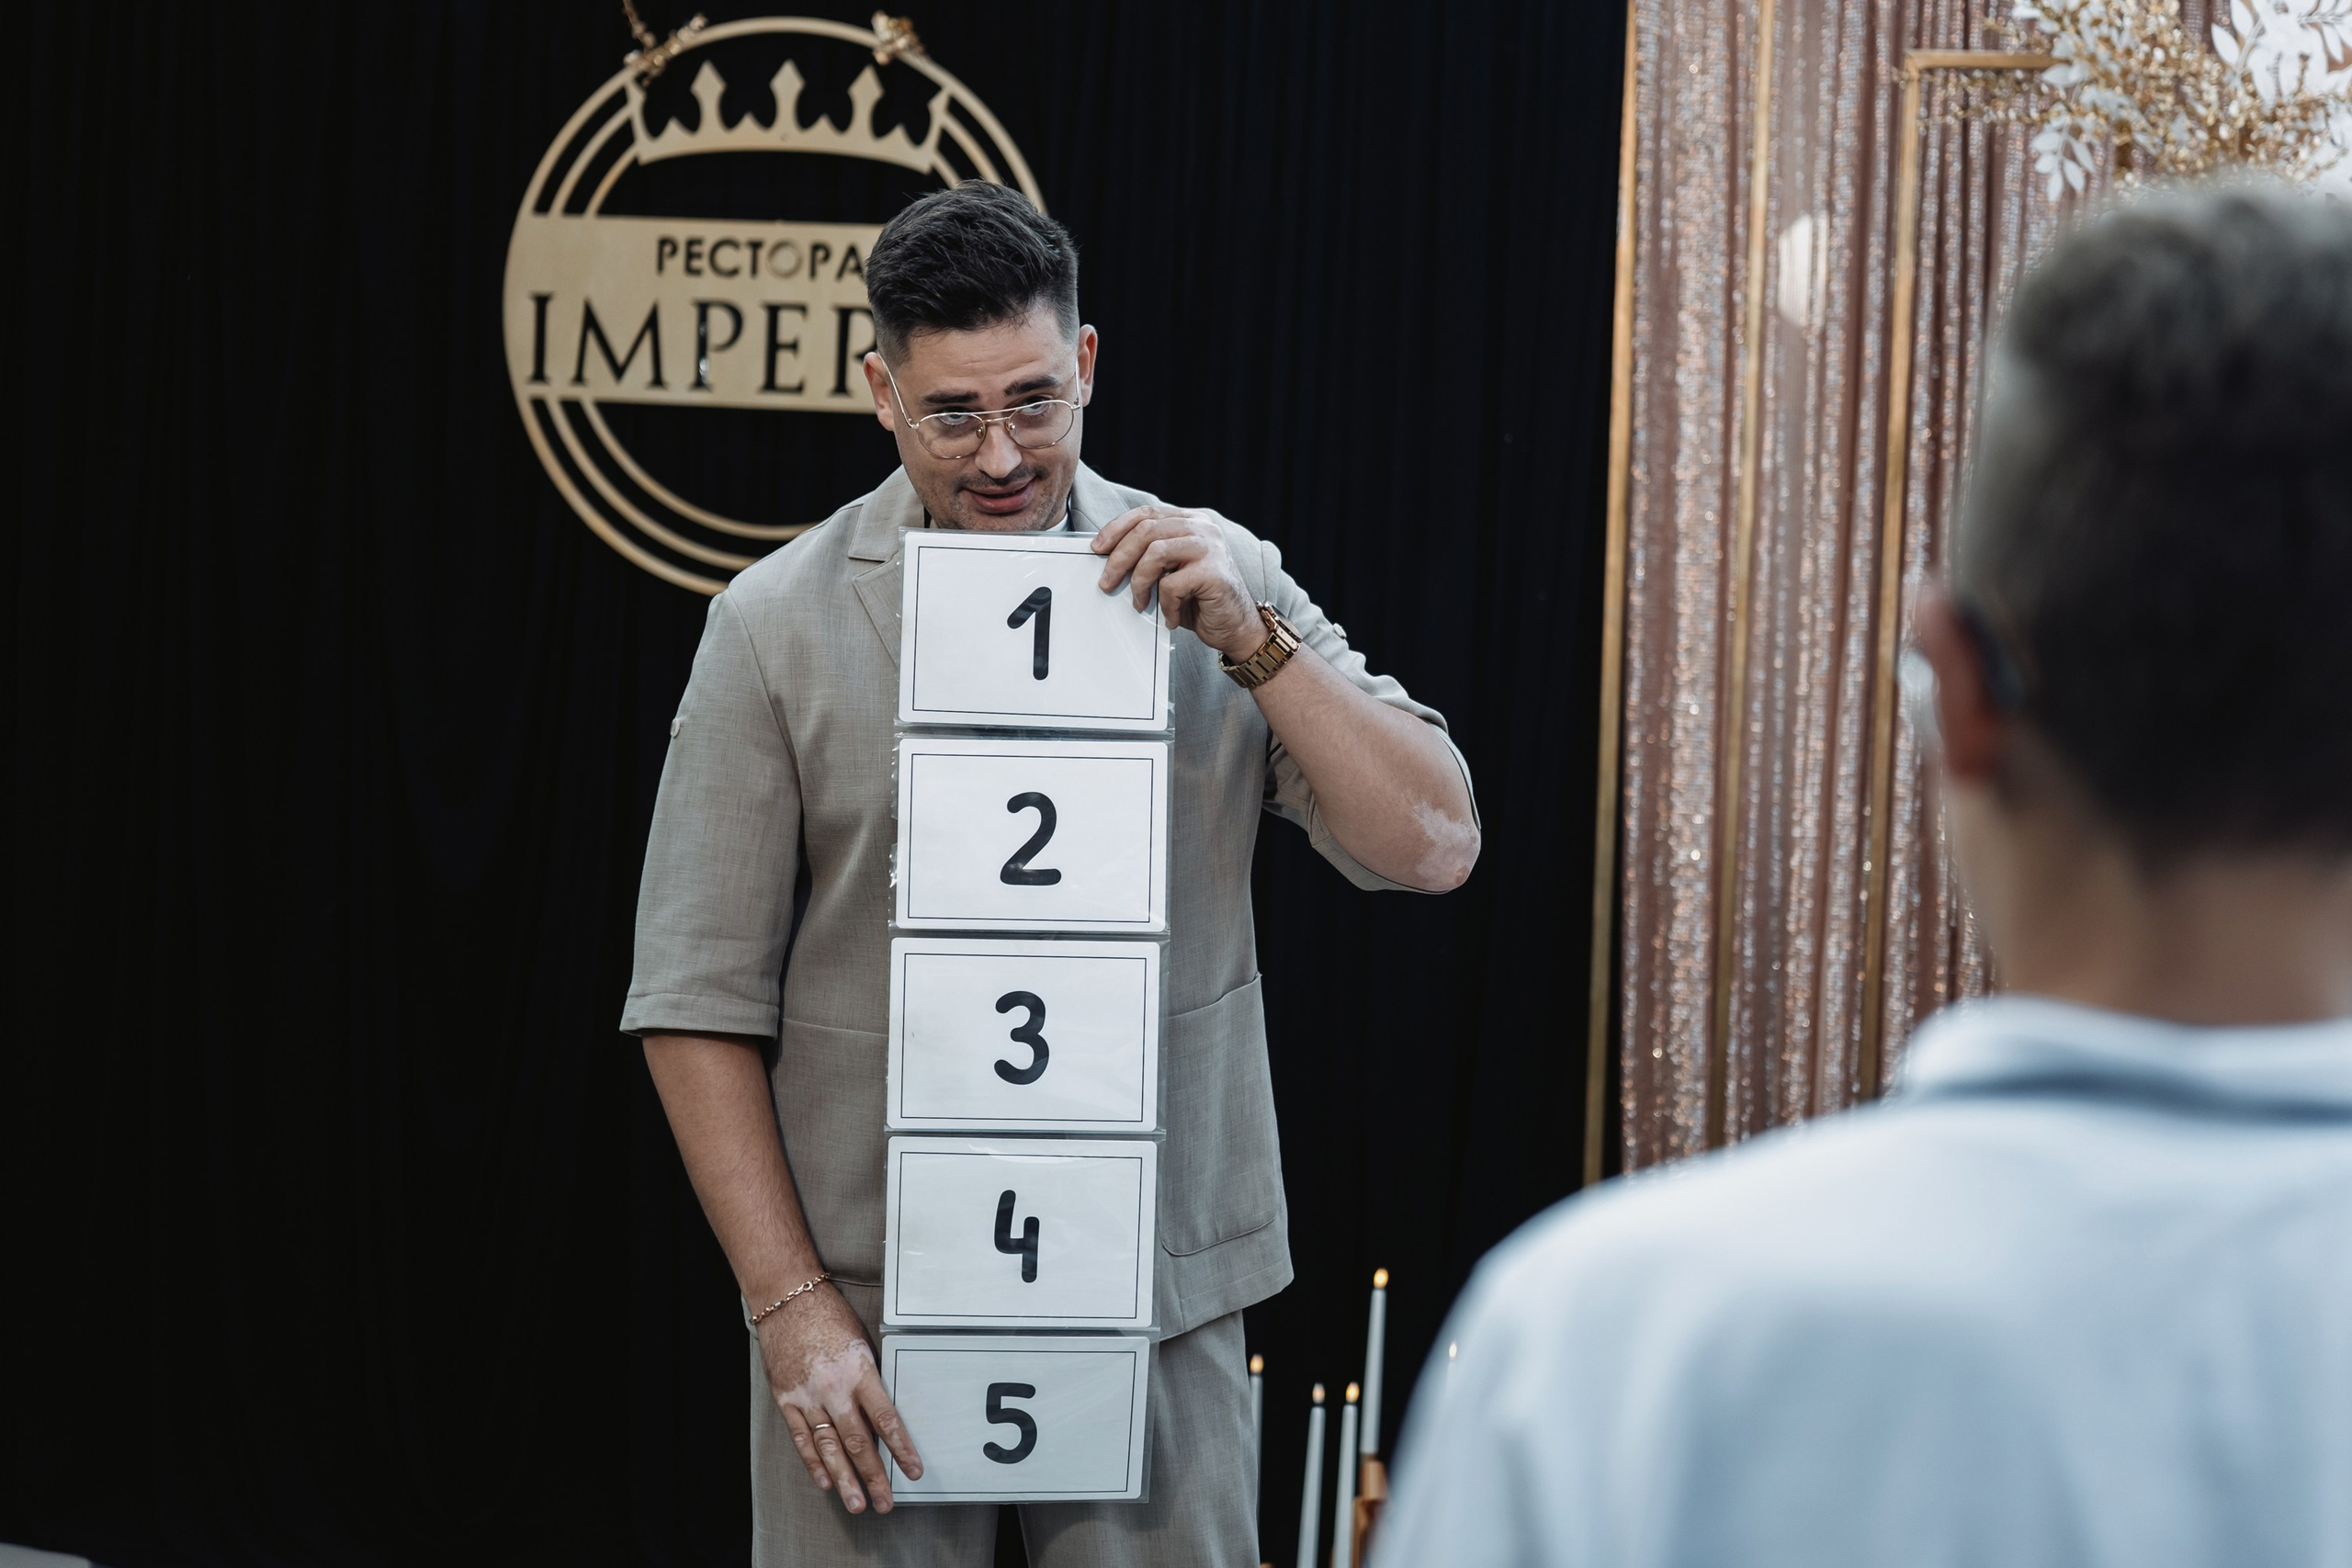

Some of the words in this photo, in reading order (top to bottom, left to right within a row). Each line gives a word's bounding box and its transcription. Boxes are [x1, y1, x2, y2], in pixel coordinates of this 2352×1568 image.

[1006, 586, 1053, 681] 1
[1000, 791, 1062, 886] 2
[993, 990, 1050, 1086] 3
[993, 1189, 1040, 1284] 4
[982, 1382, 1038, 1465] 5
